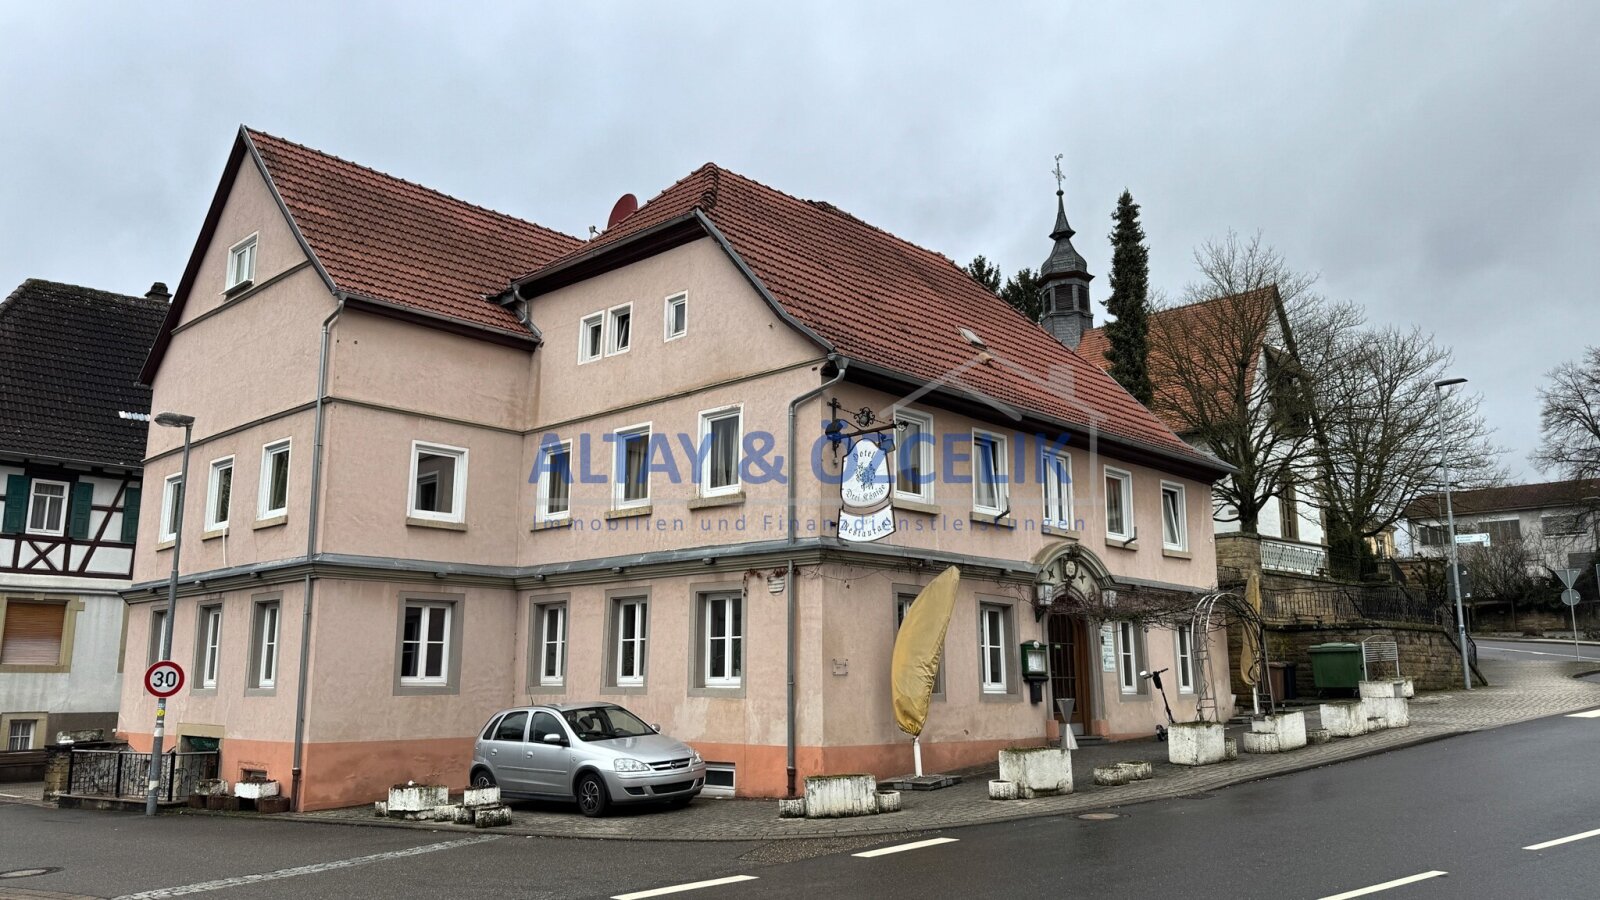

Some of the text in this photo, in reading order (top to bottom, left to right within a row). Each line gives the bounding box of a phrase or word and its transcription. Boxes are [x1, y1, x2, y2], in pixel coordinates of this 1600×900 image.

[853, 450, 875, 462] Hotel
[846, 485, 886, 502] Drei Könige
[153, 671, 177, 688] 30
